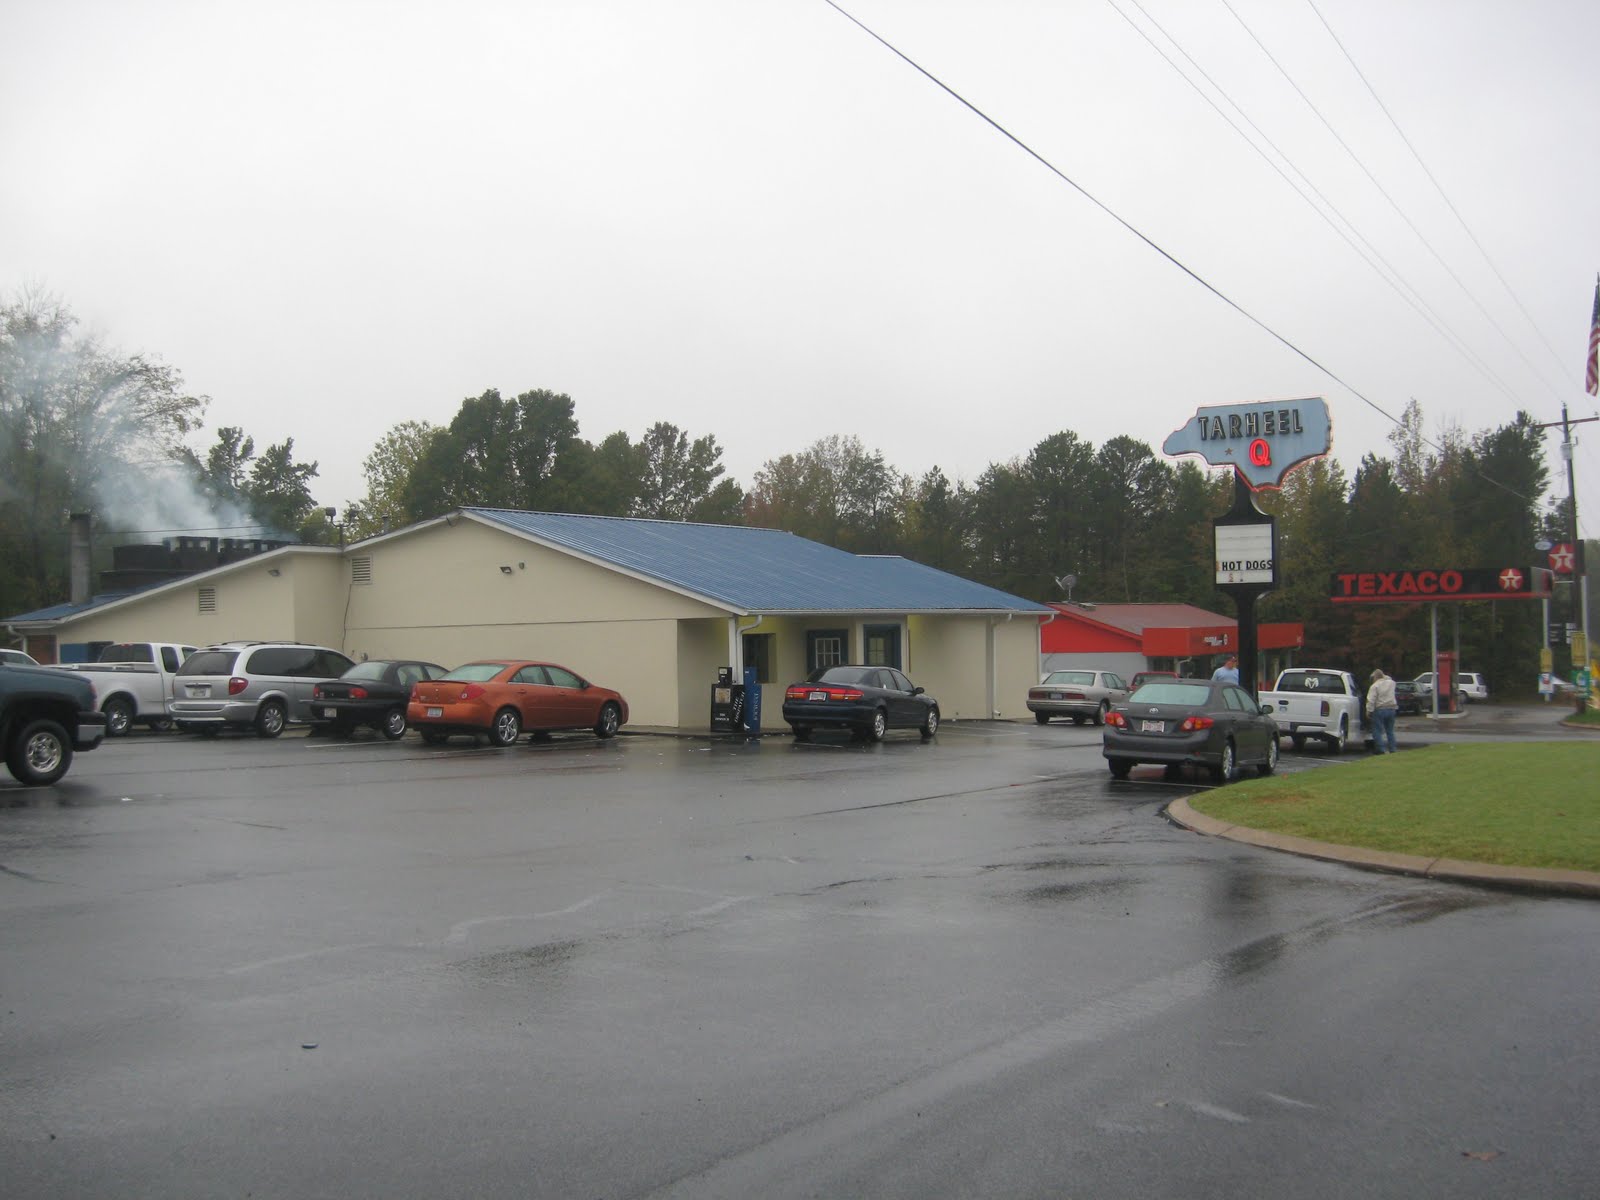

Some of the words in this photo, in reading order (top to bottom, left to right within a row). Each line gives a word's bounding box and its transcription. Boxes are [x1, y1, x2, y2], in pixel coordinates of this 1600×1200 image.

[1198, 409, 1304, 440] TARHEEL
[1249, 438, 1272, 466] Q
[1222, 560, 1242, 571] HOT
[1246, 559, 1273, 571] DOGS
[1338, 570, 1464, 595] TEXACO
